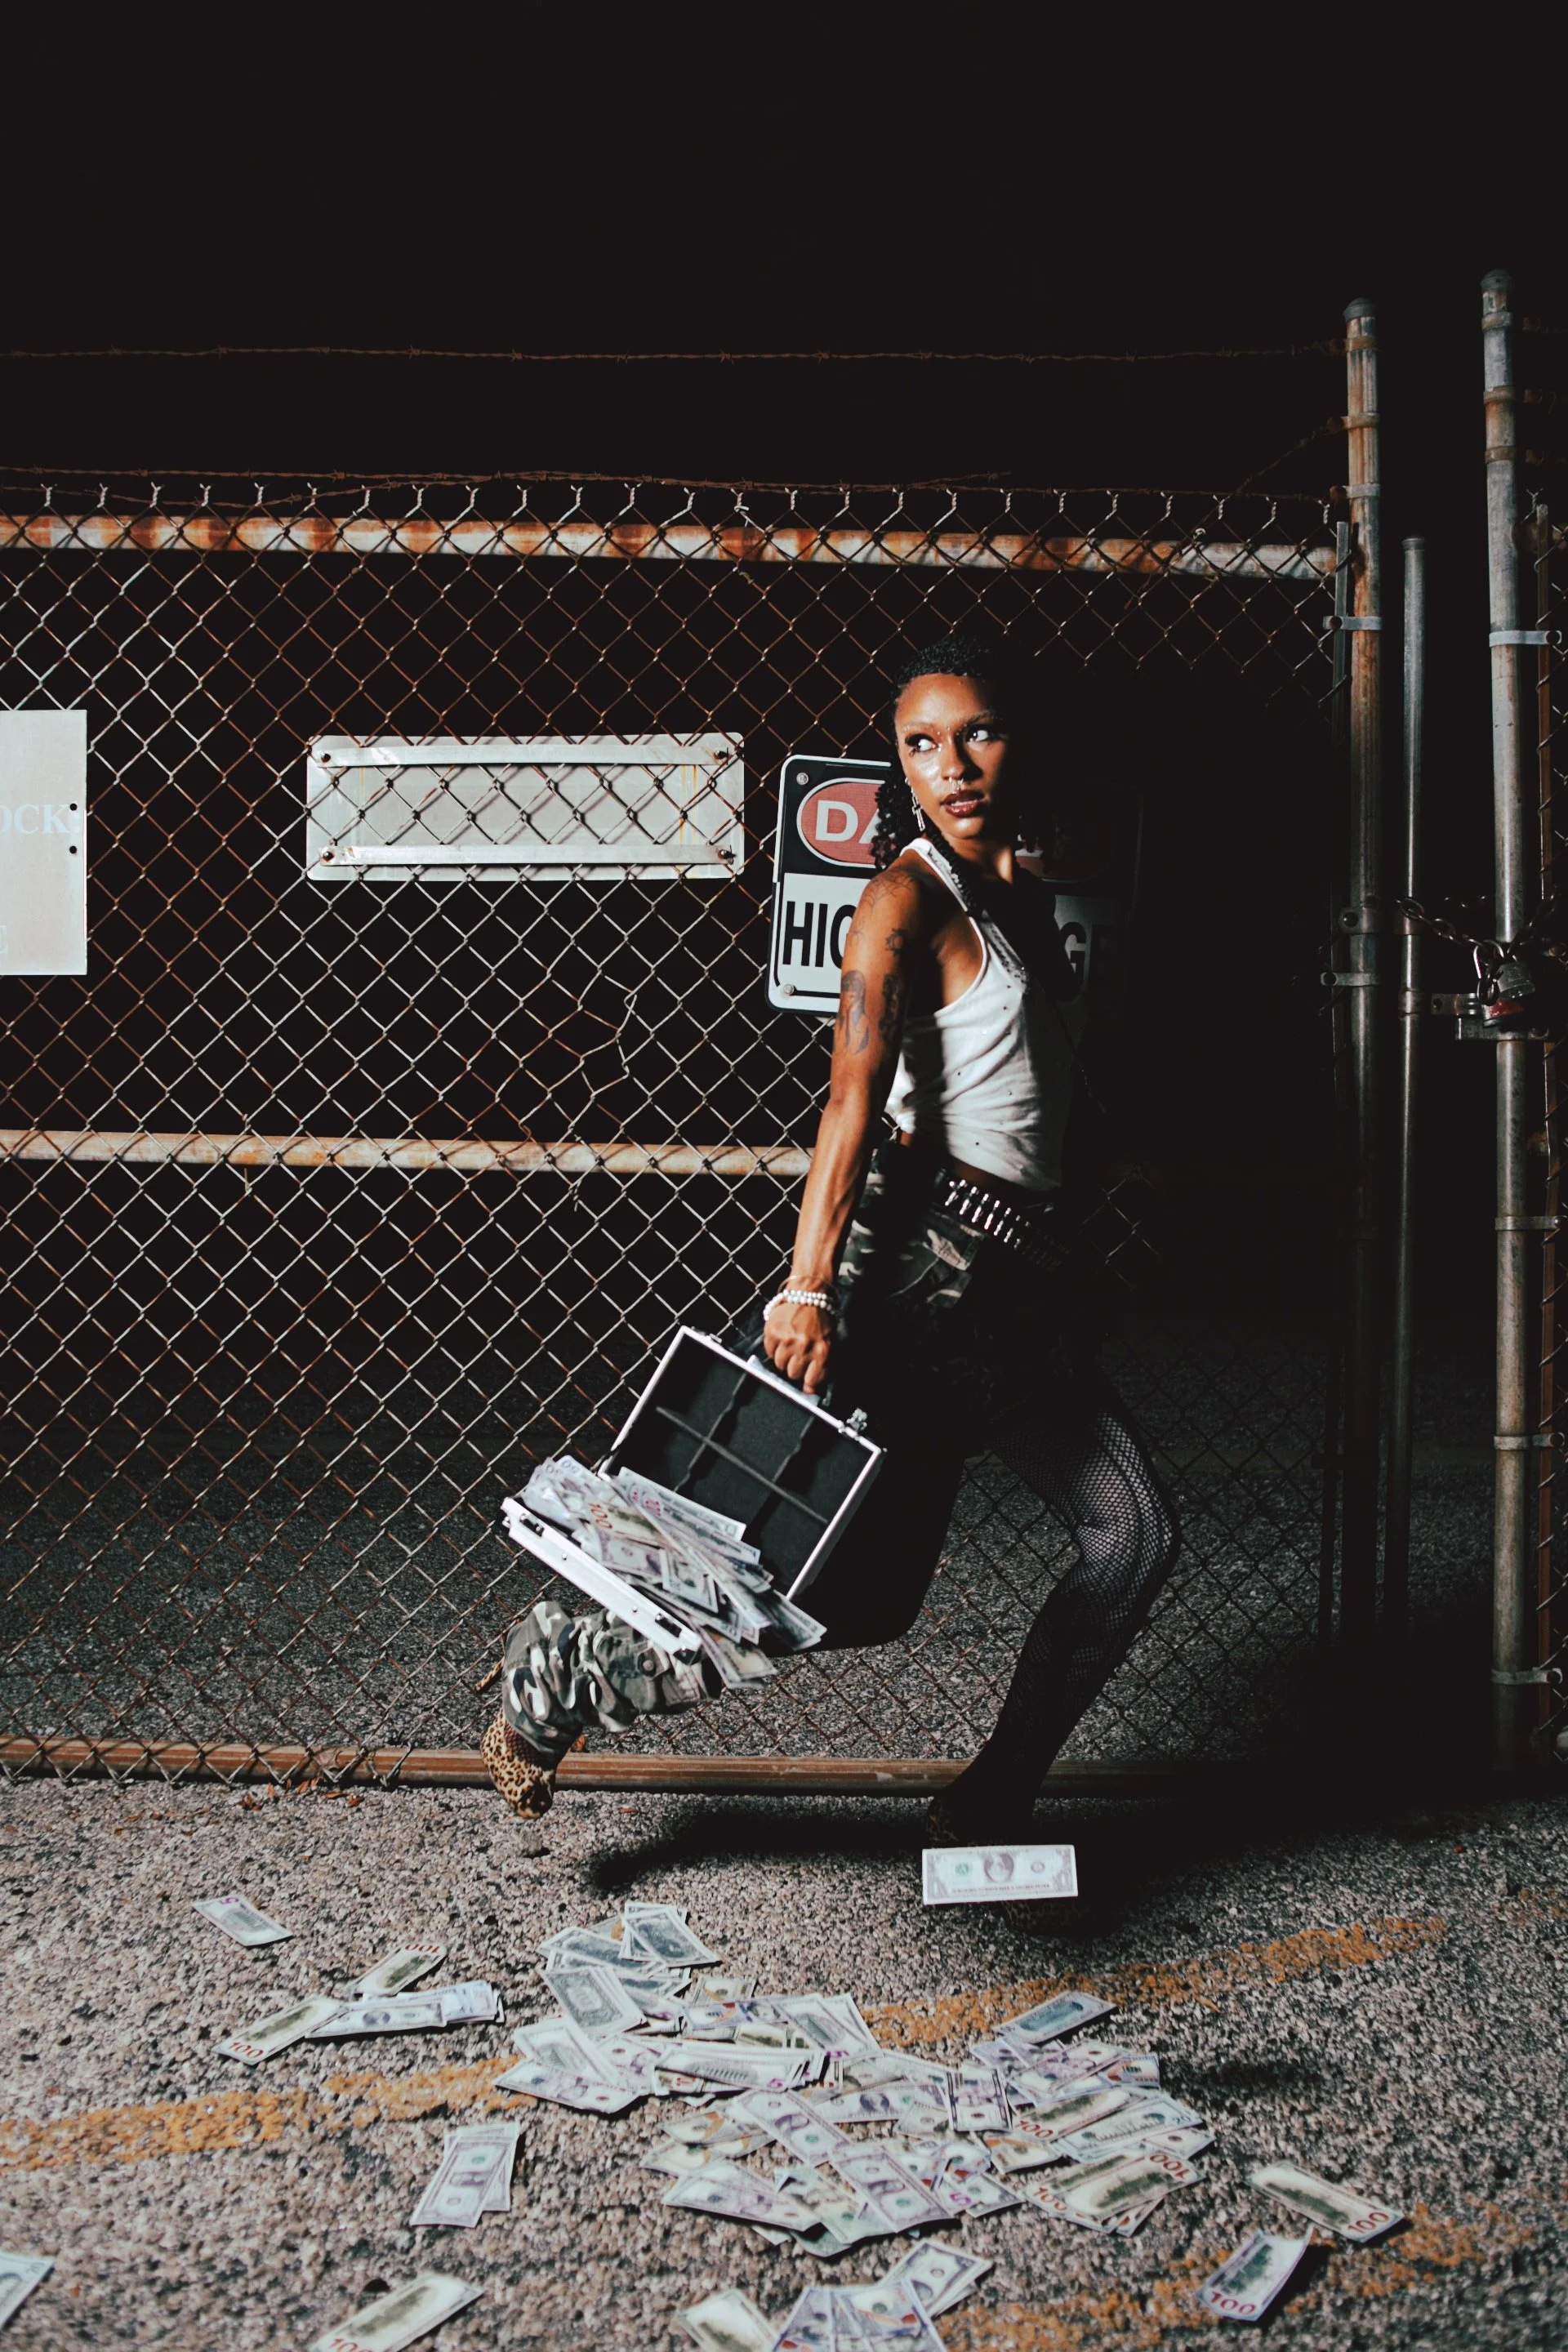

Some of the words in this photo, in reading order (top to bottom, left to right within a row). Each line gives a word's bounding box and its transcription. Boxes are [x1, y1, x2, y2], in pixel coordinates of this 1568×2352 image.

[228, 2042, 264, 2059] 100
[1015, 2120, 1054, 2139] 100
[1149, 2154, 1190, 2180] 100
[948, 2191, 971, 2206] 5
[1348, 2212, 1390, 2234] 100
[1210, 2291, 1257, 2314] 100
[329, 2338, 373, 2352] 10
